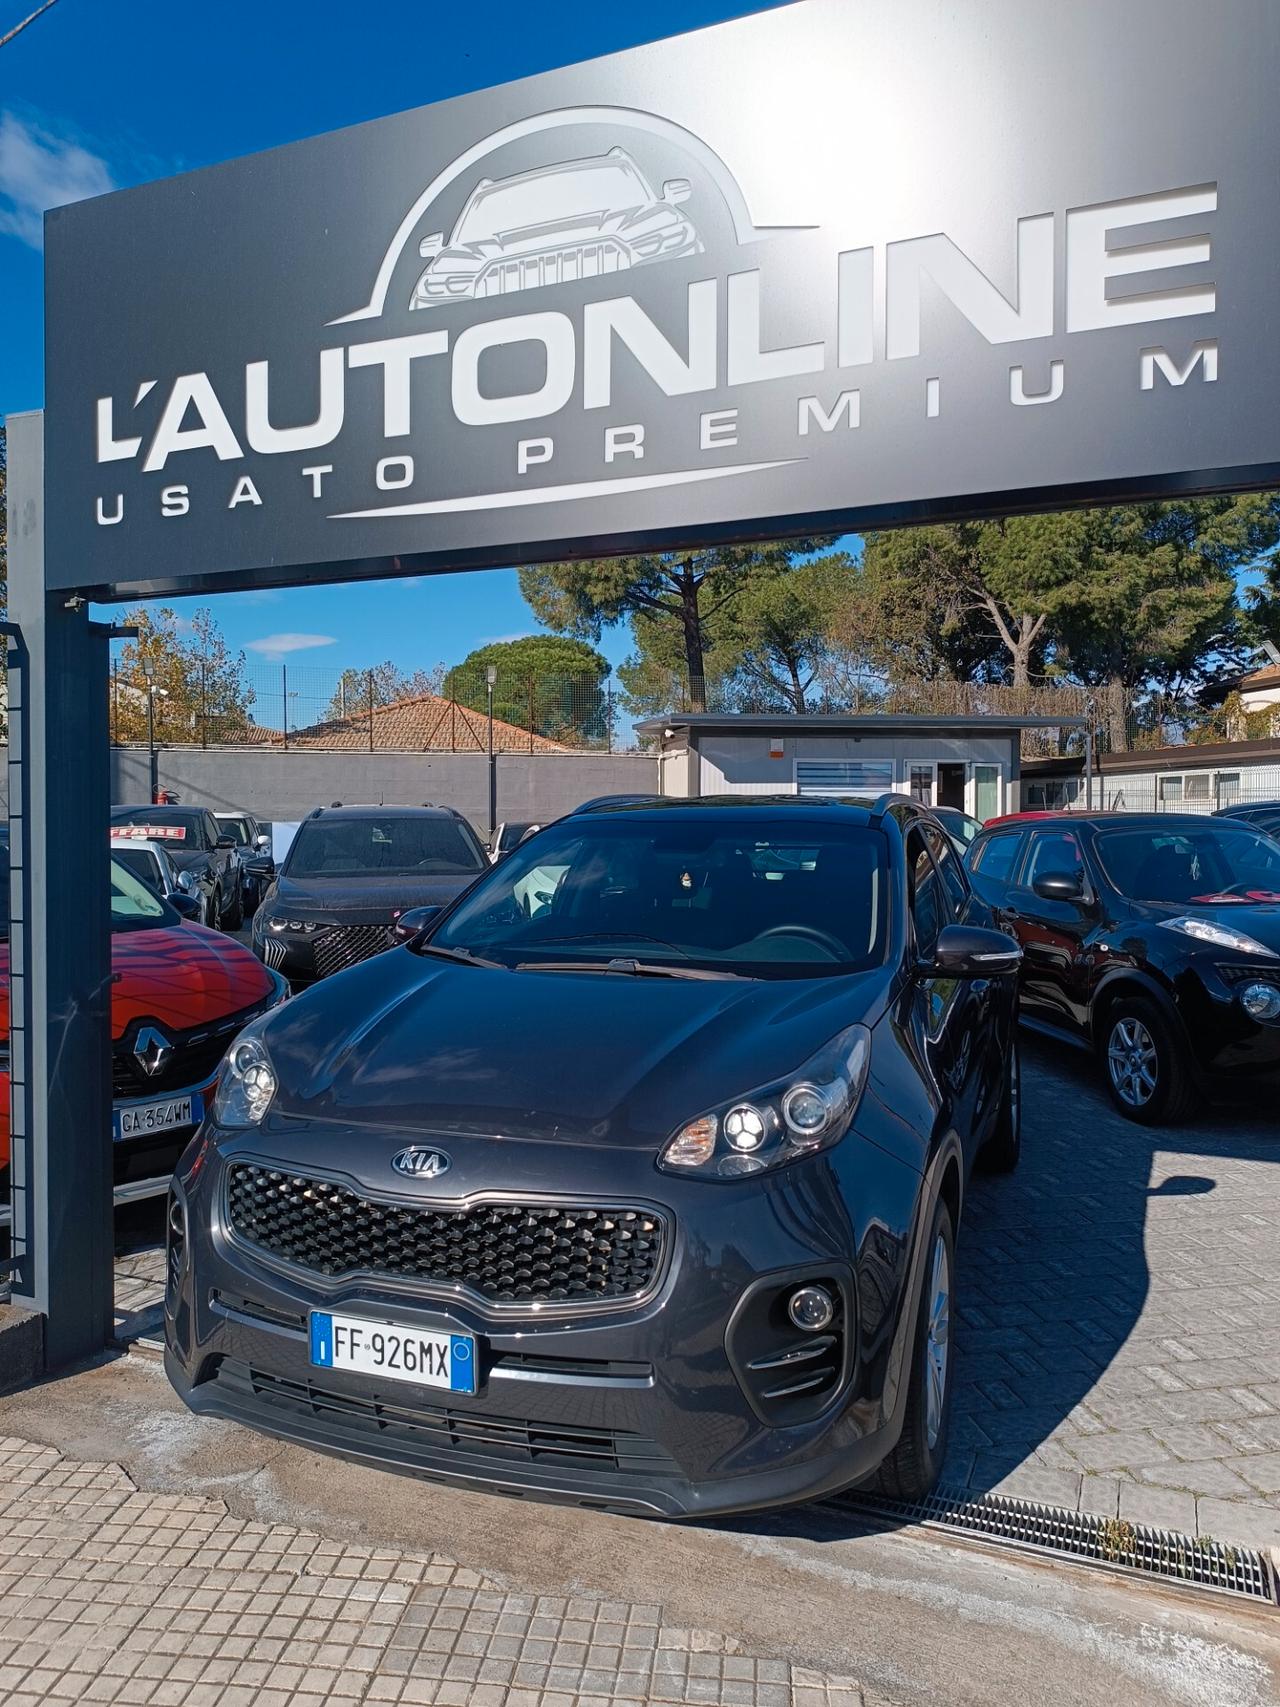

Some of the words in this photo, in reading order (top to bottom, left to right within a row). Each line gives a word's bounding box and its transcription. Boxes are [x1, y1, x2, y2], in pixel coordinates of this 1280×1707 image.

[96, 454, 415, 526] USATO
[517, 337, 1219, 475] PREMIUM
[399, 1151, 440, 1172] KIA
